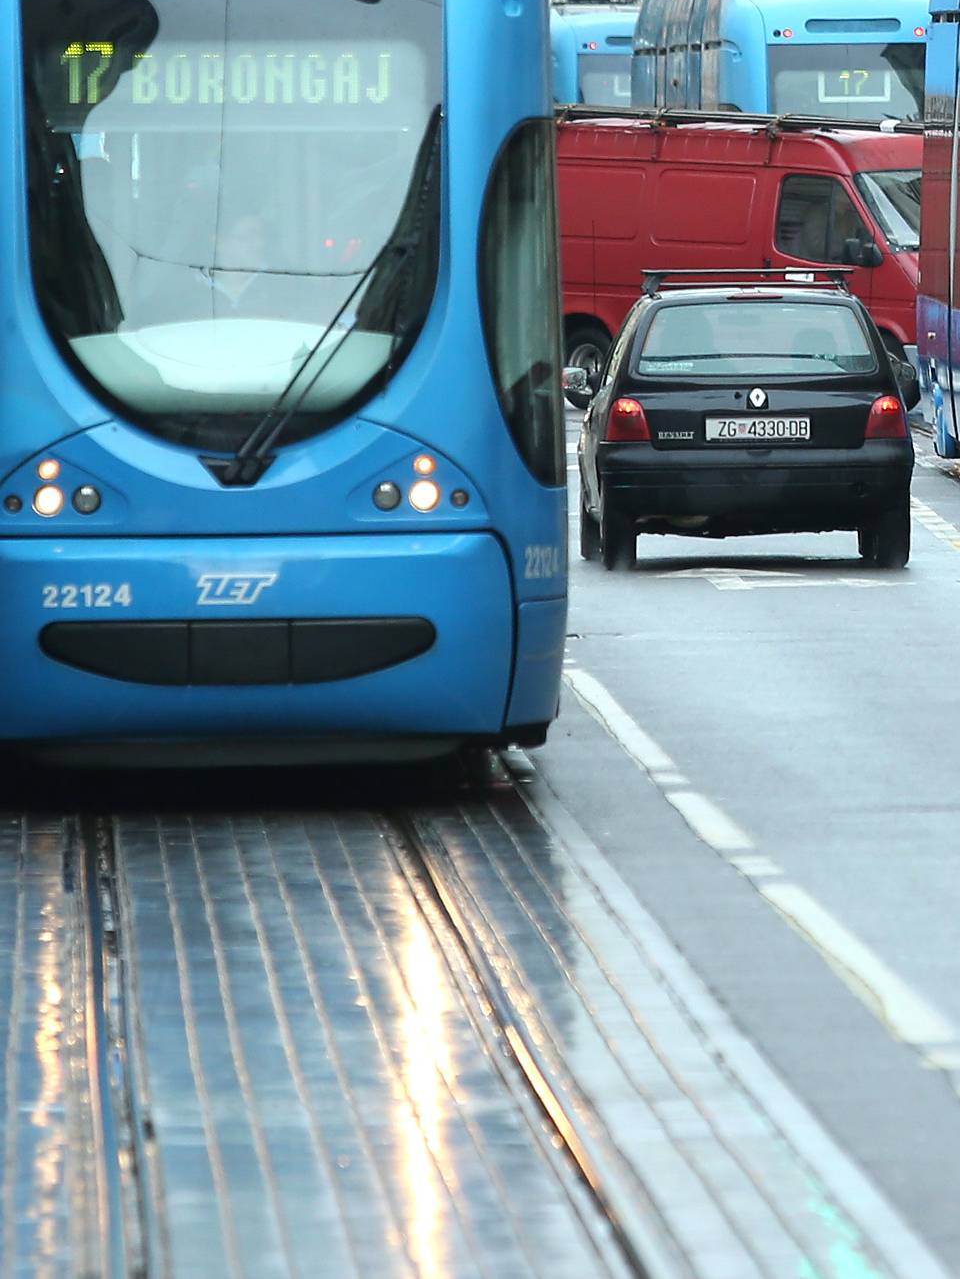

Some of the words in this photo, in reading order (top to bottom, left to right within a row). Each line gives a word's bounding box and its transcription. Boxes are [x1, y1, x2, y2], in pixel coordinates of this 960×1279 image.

[60, 41, 113, 104] 17
[718, 421, 737, 437] ZG
[42, 584, 133, 608] 22124
